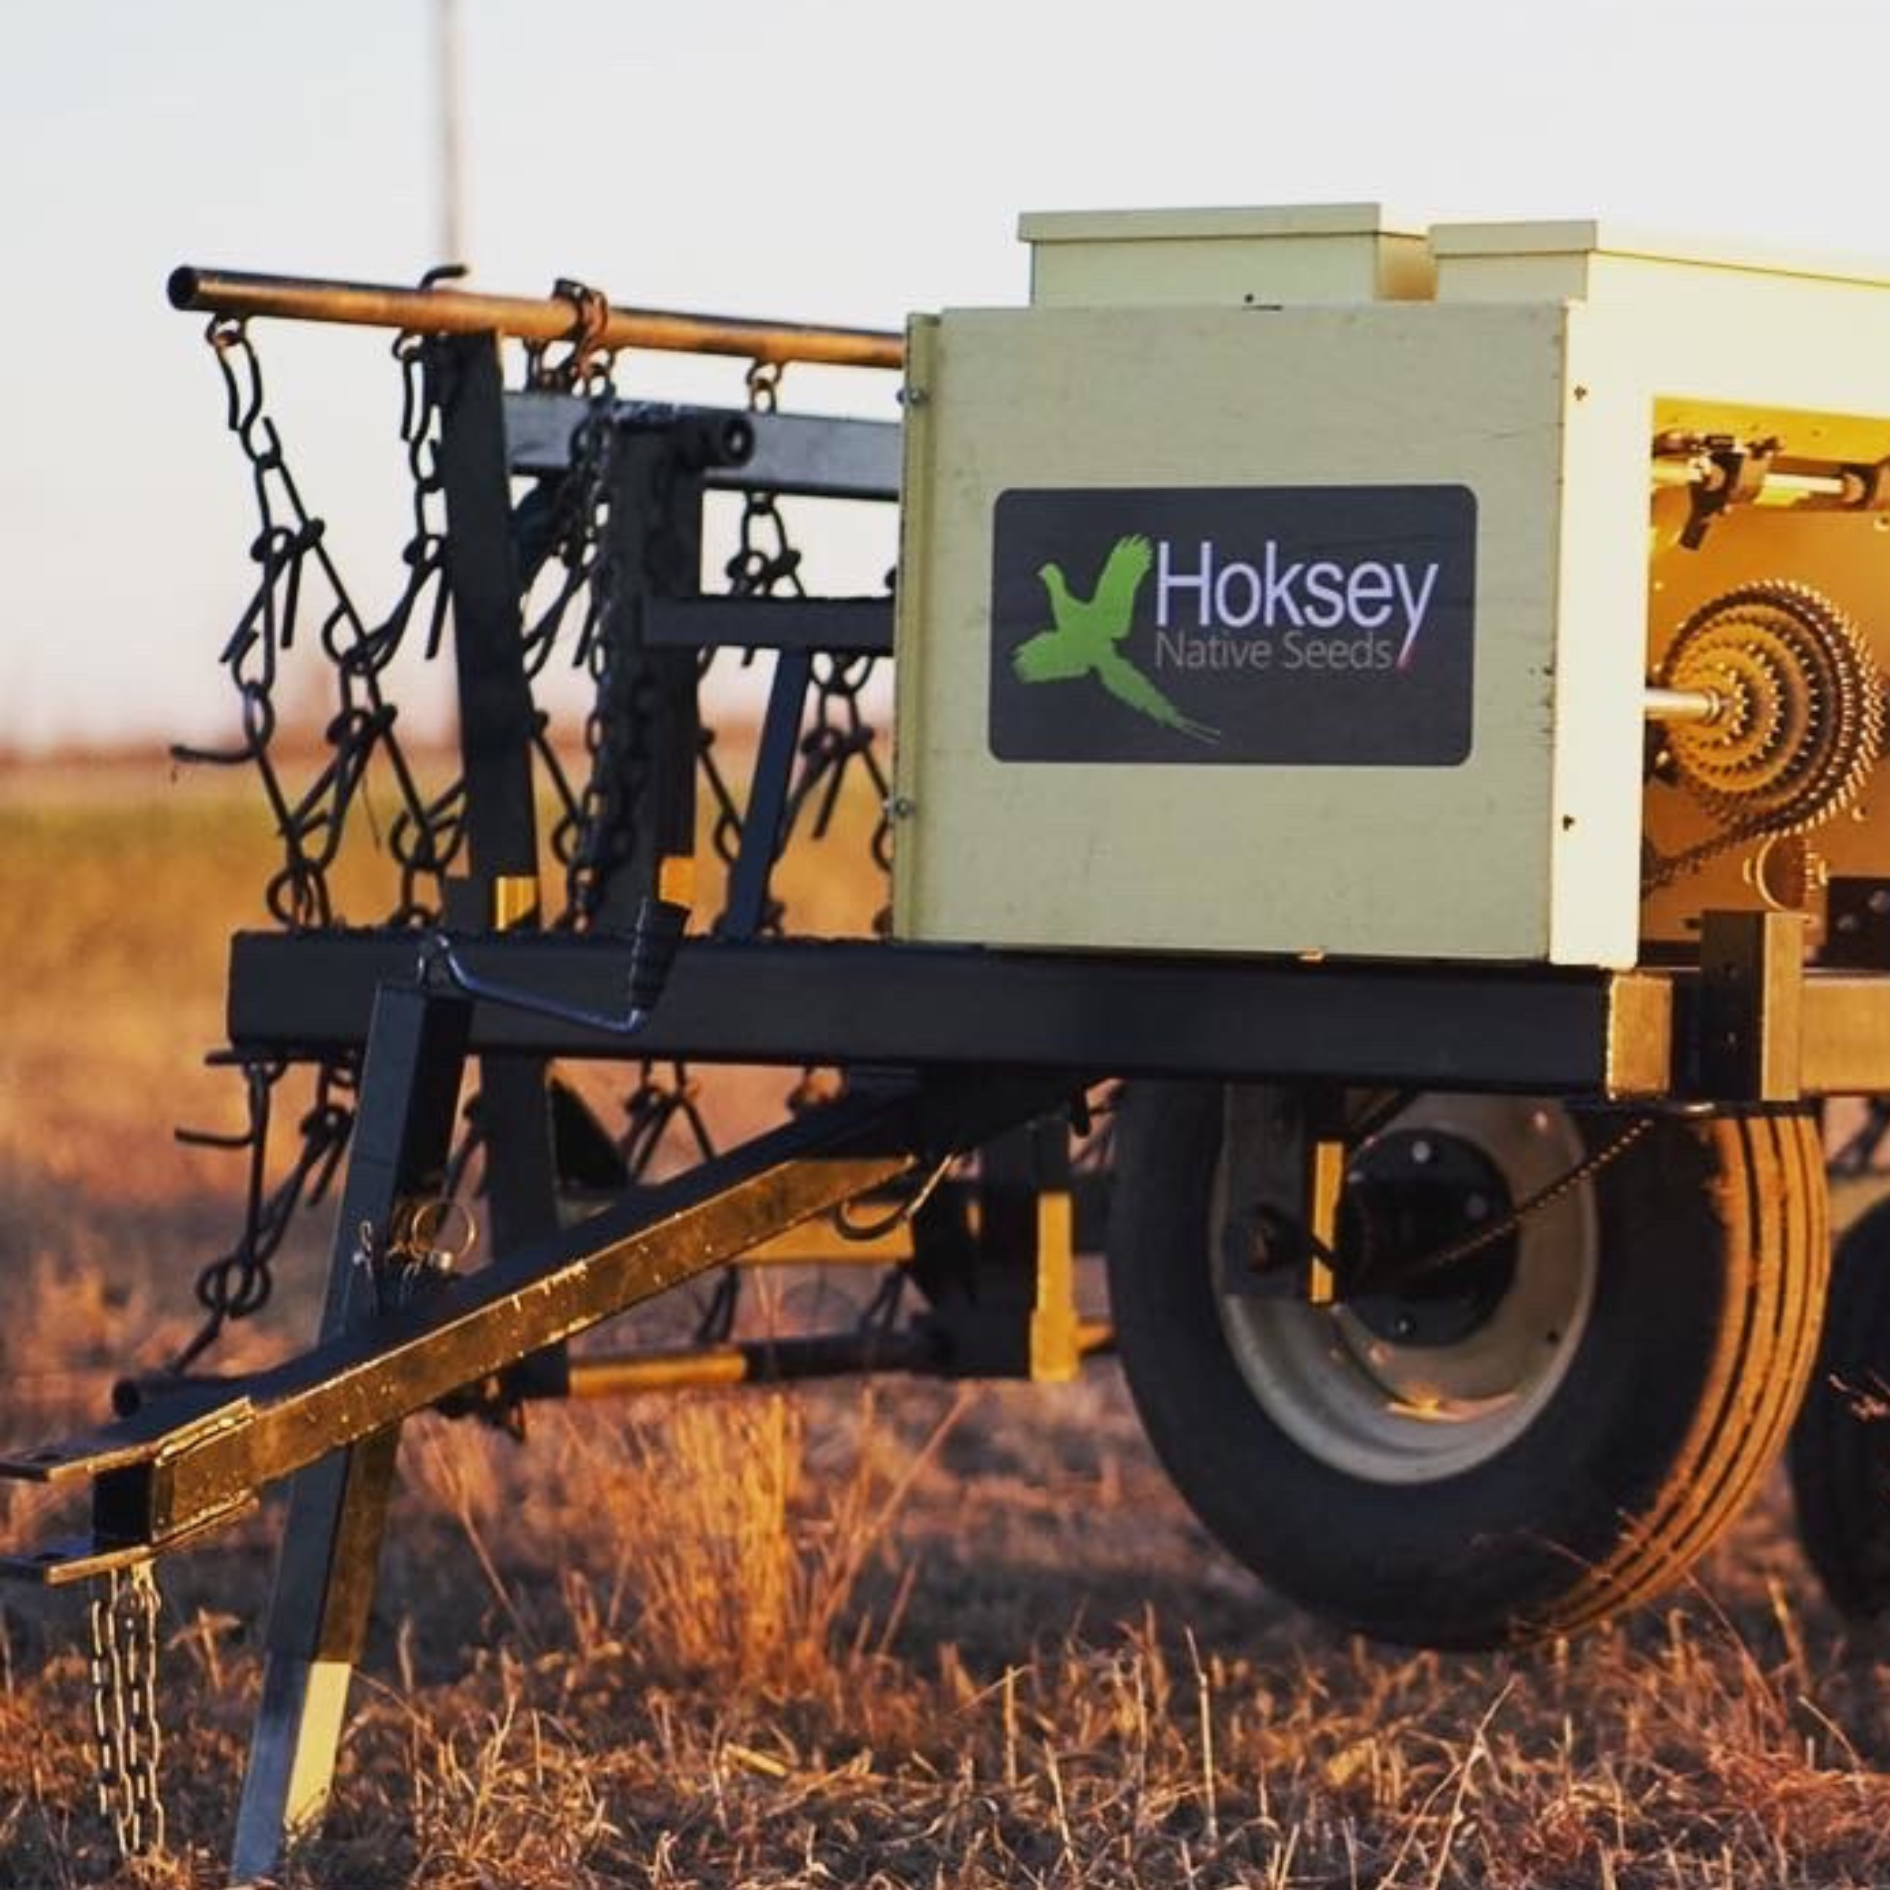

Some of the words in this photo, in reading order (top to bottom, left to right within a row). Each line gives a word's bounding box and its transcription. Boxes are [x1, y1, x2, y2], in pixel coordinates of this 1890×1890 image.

[1156, 540, 1439, 669] Hoksey
[1156, 631, 1272, 669] Native
[1284, 630, 1393, 669] Seeds
